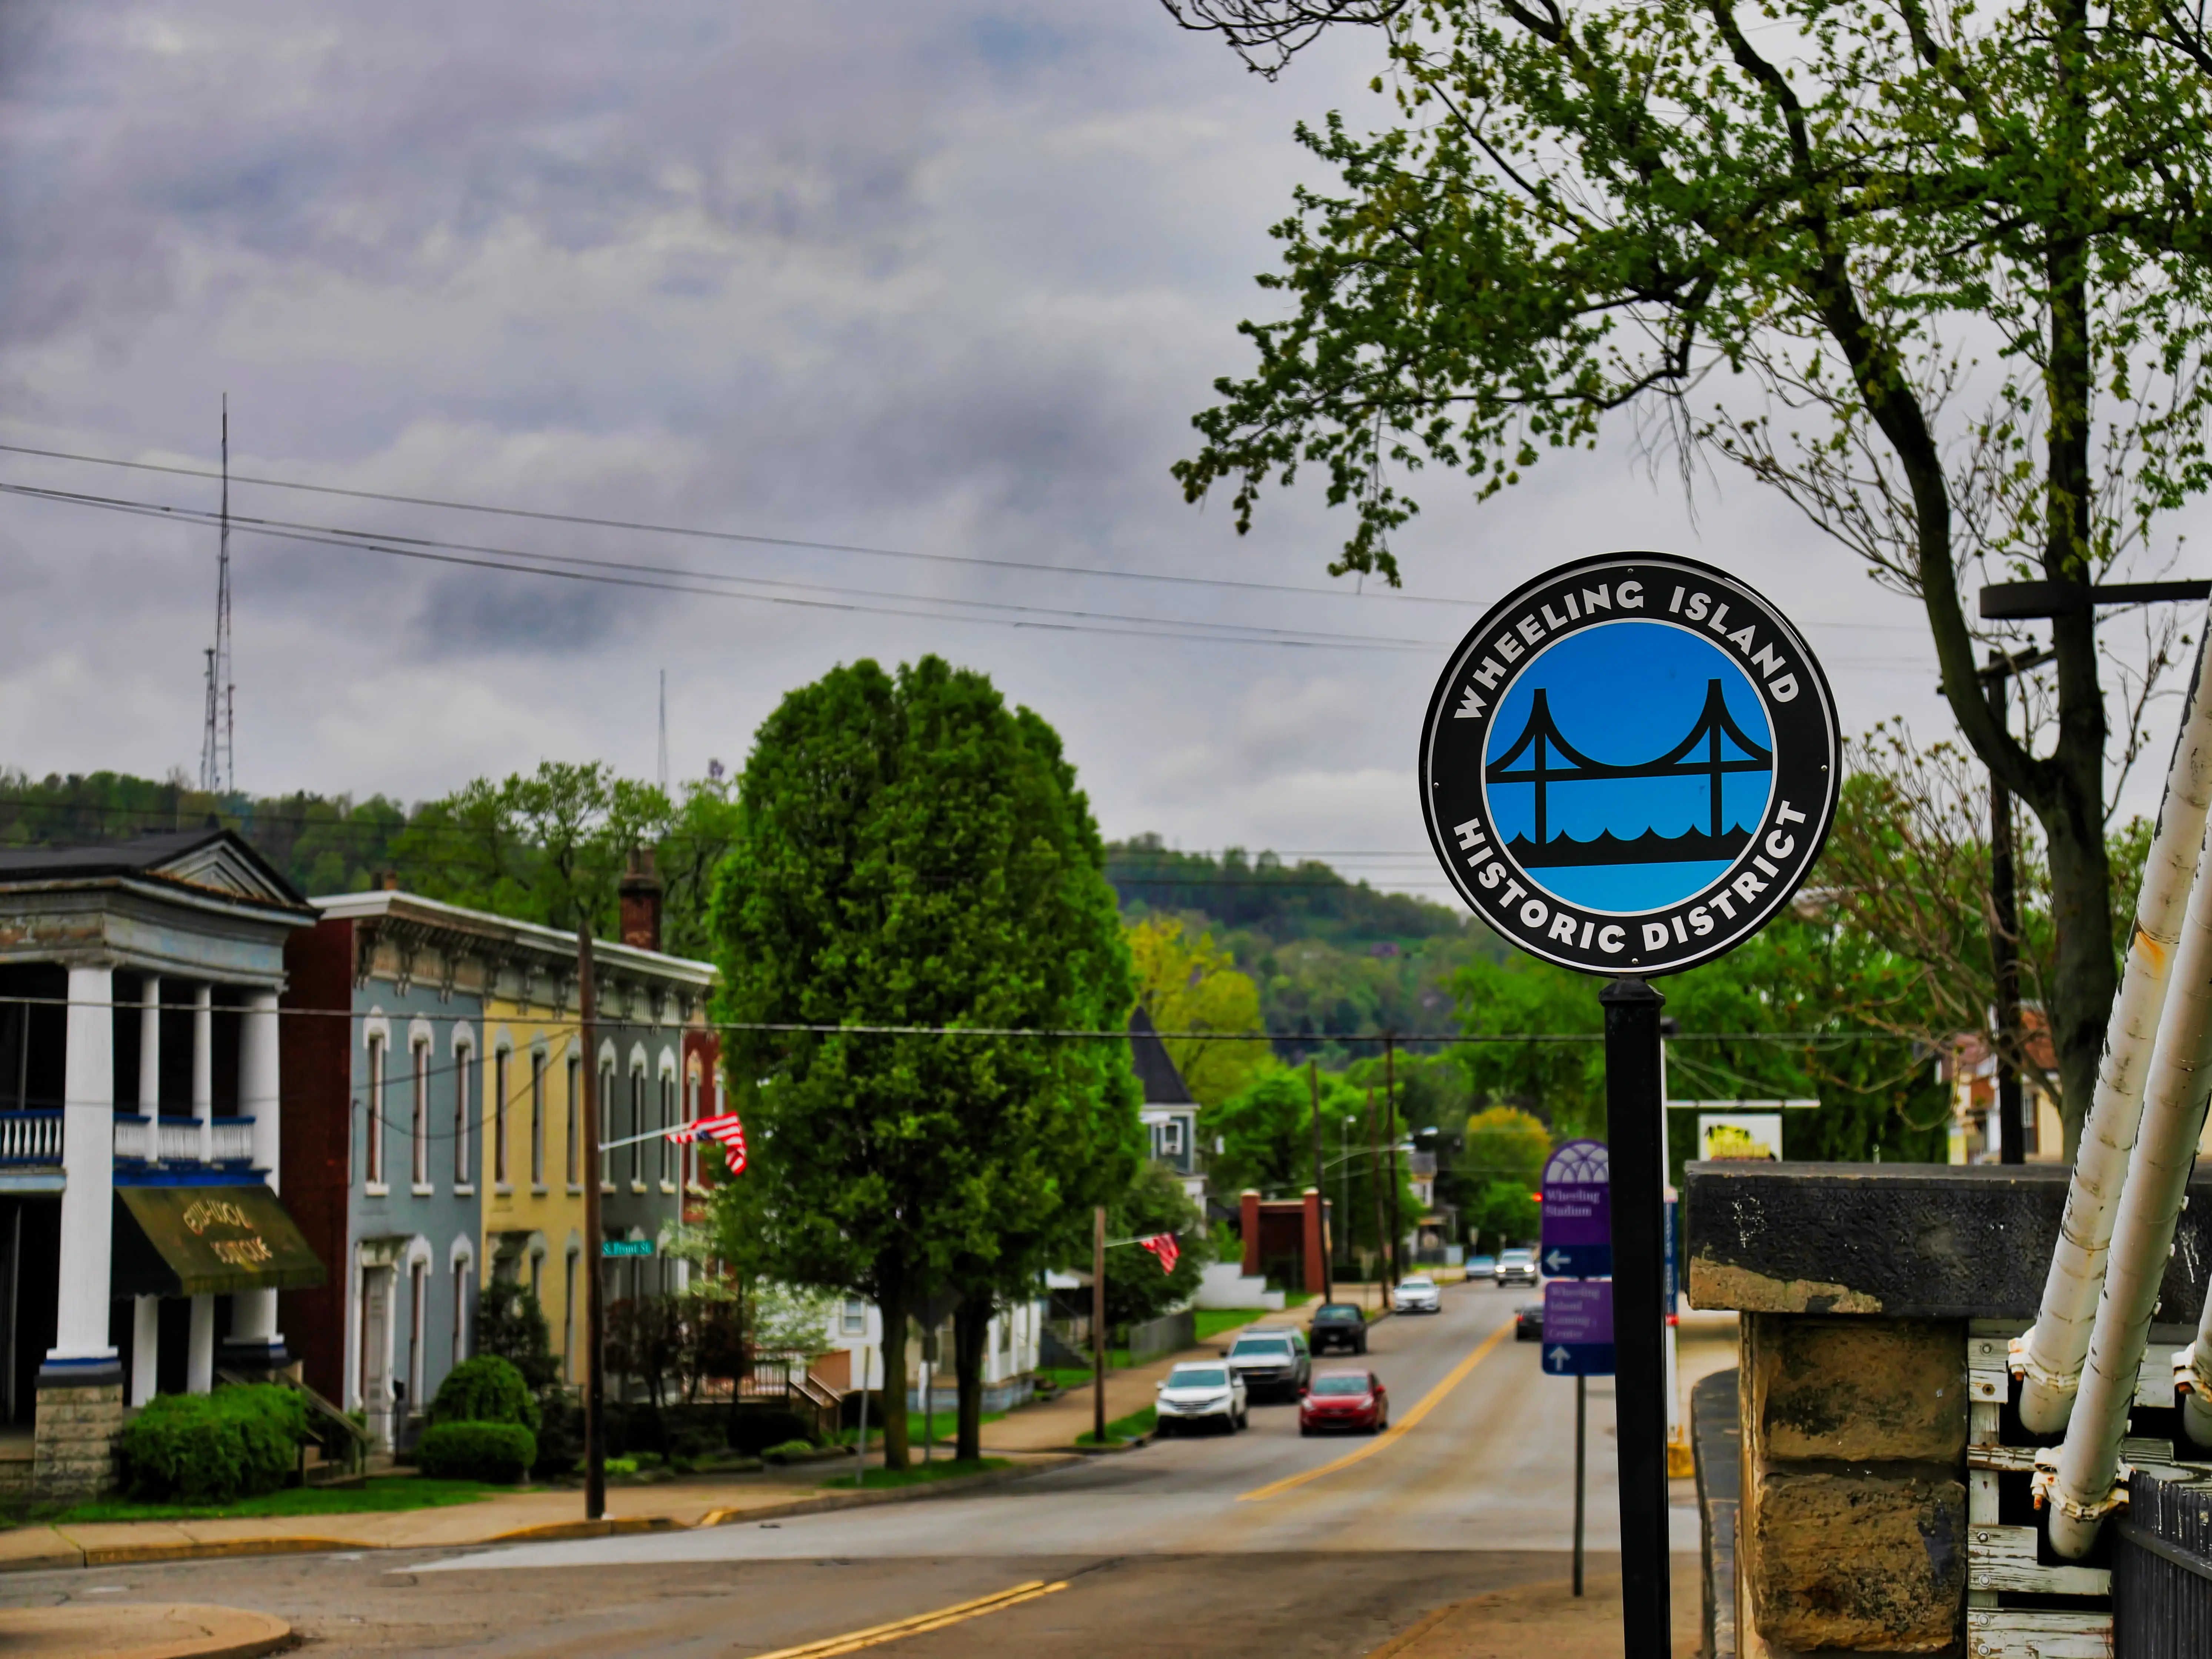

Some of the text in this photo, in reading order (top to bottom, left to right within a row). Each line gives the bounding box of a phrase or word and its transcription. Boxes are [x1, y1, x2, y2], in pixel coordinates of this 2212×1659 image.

[1454, 580, 1799, 719] WHEELING ISLAND
[1454, 800, 1806, 953] HISTORIC DISTRICT
[1546, 1205, 1592, 1217] Stadium
[1547, 1189, 1600, 1204] Wheeling
